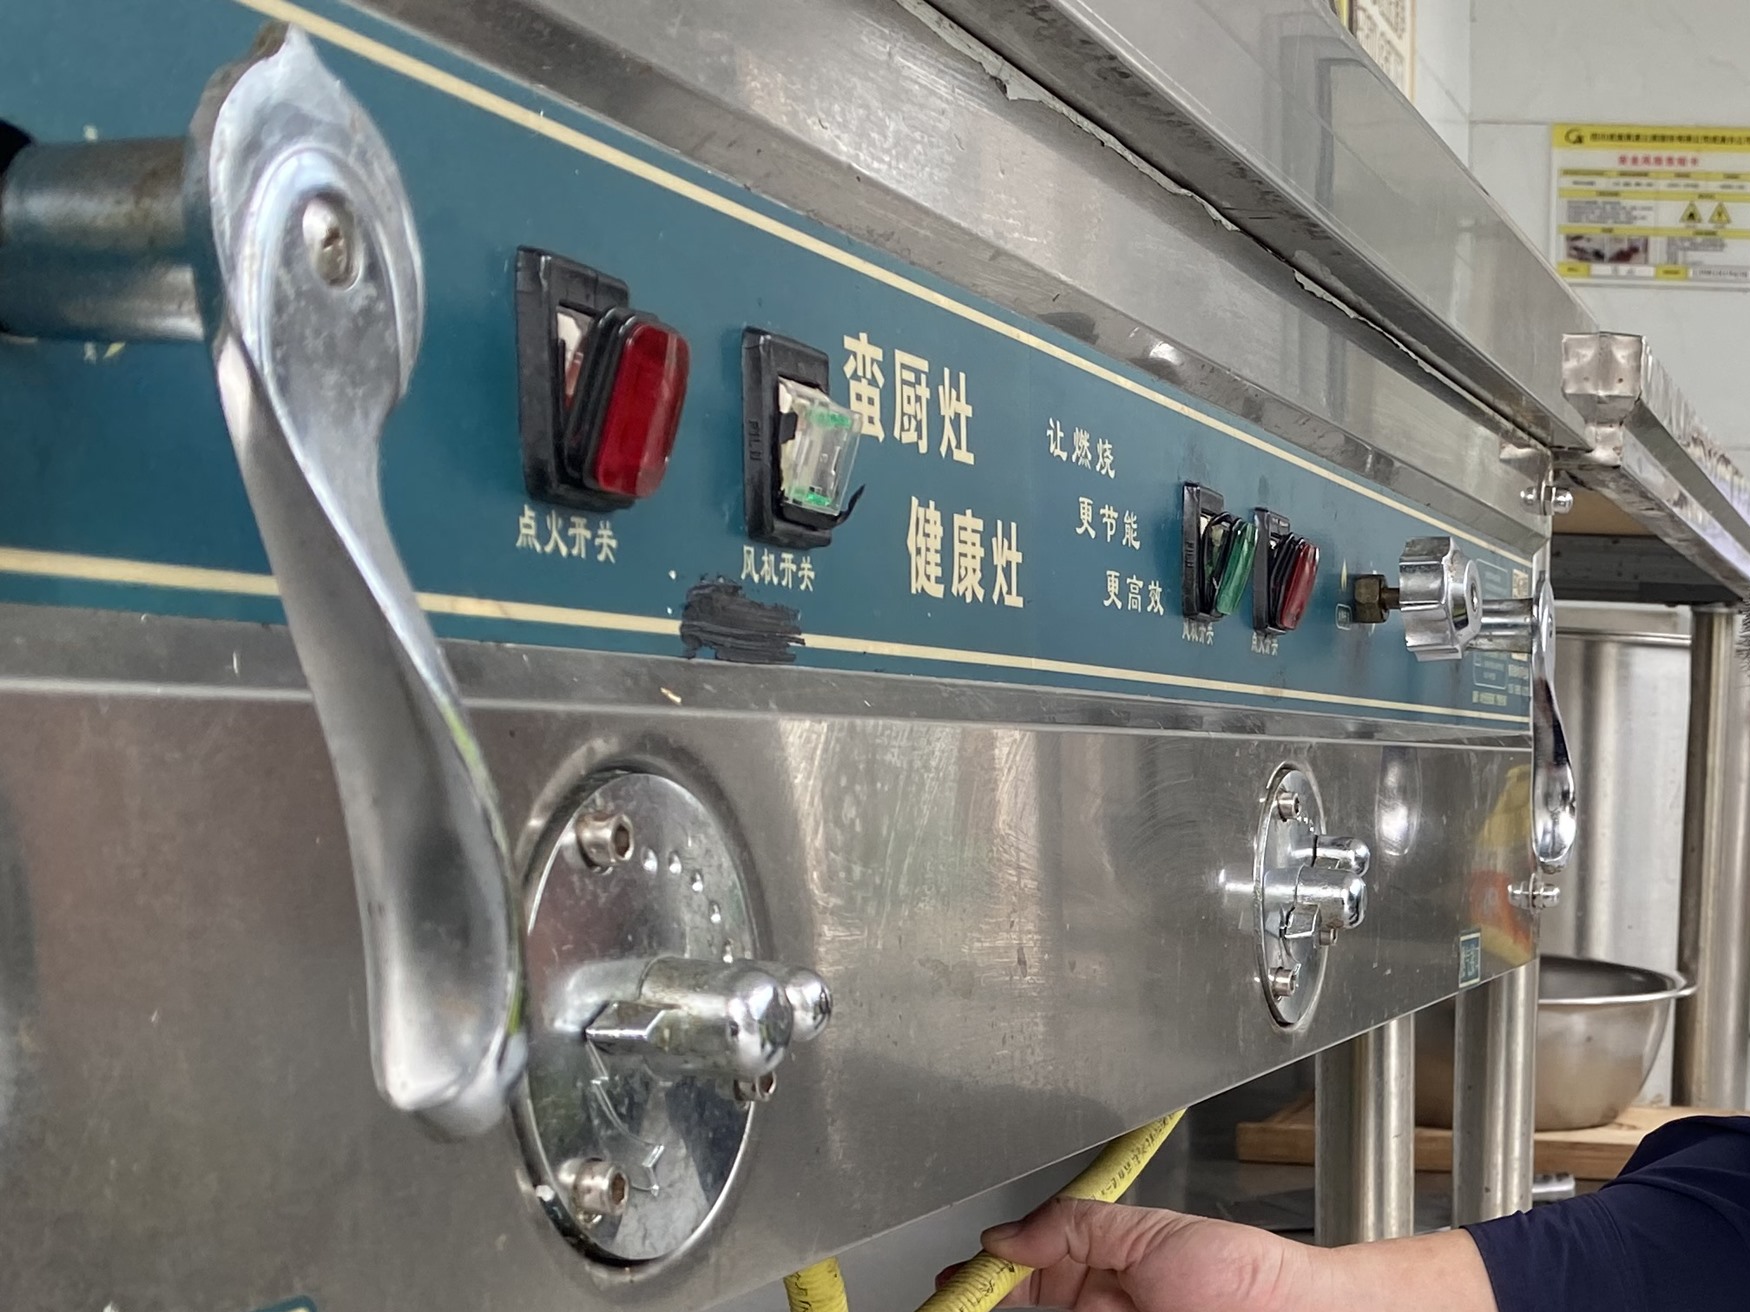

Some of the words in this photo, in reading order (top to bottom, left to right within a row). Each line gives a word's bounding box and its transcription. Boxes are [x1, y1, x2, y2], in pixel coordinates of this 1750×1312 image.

[842, 332, 975, 466] 蛮厨灶
[1046, 417, 1116, 479] 让燃烧
[515, 504, 618, 564] 点火开关
[907, 496, 1024, 608] 健康灶
[1075, 497, 1141, 550] 更节能
[741, 545, 815, 592] 风机开关
[1103, 570, 1164, 616] 更高效
